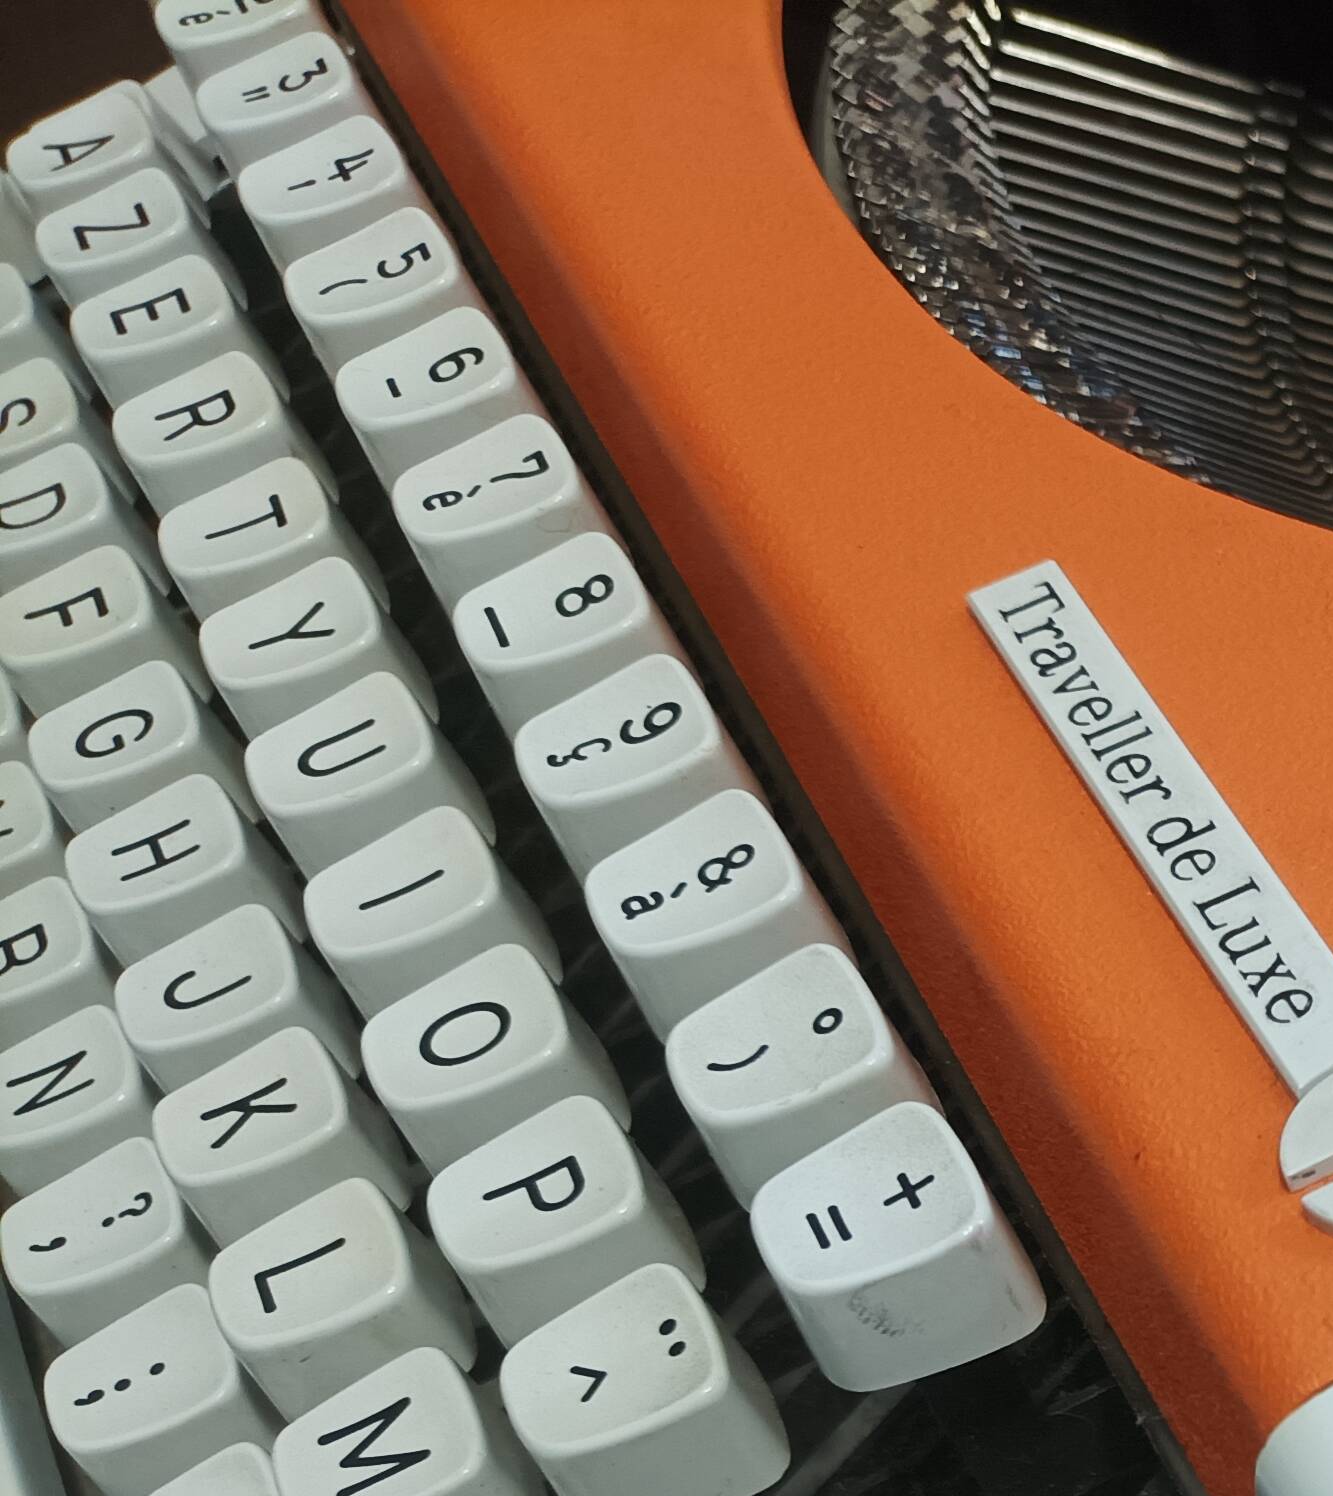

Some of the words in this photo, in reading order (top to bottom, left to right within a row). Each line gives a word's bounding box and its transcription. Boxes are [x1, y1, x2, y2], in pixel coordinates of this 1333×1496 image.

[278, 58, 328, 92] 3
[43, 135, 114, 171] A
[328, 149, 374, 182] 4
[73, 203, 150, 251] Z
[377, 243, 431, 278] 5
[110, 288, 191, 335] E
[429, 347, 484, 382] 6
[155, 390, 235, 441] R
[490, 451, 549, 483] 7
[0, 483, 66, 530] D
[205, 494, 287, 539] T
[24, 587, 109, 627] F
[555, 574, 614, 617] 8
[248, 602, 335, 649] Y
[75, 709, 153, 758] G
[620, 702, 682, 744] 9
[298, 719, 386, 777] U
[998, 581, 1172, 804] Traveller
[1146, 816, 1217, 881] de
[1192, 876, 1314, 1025] Luxe
[111, 820, 200, 881] H
[0, 924, 48, 976] B
[164, 971, 252, 1009] J
[419, 1002, 511, 1066] O
[6, 1051, 95, 1116] N
[200, 1078, 297, 1149] K
[483, 1156, 585, 1211] P
[254, 1238, 345, 1313] L
